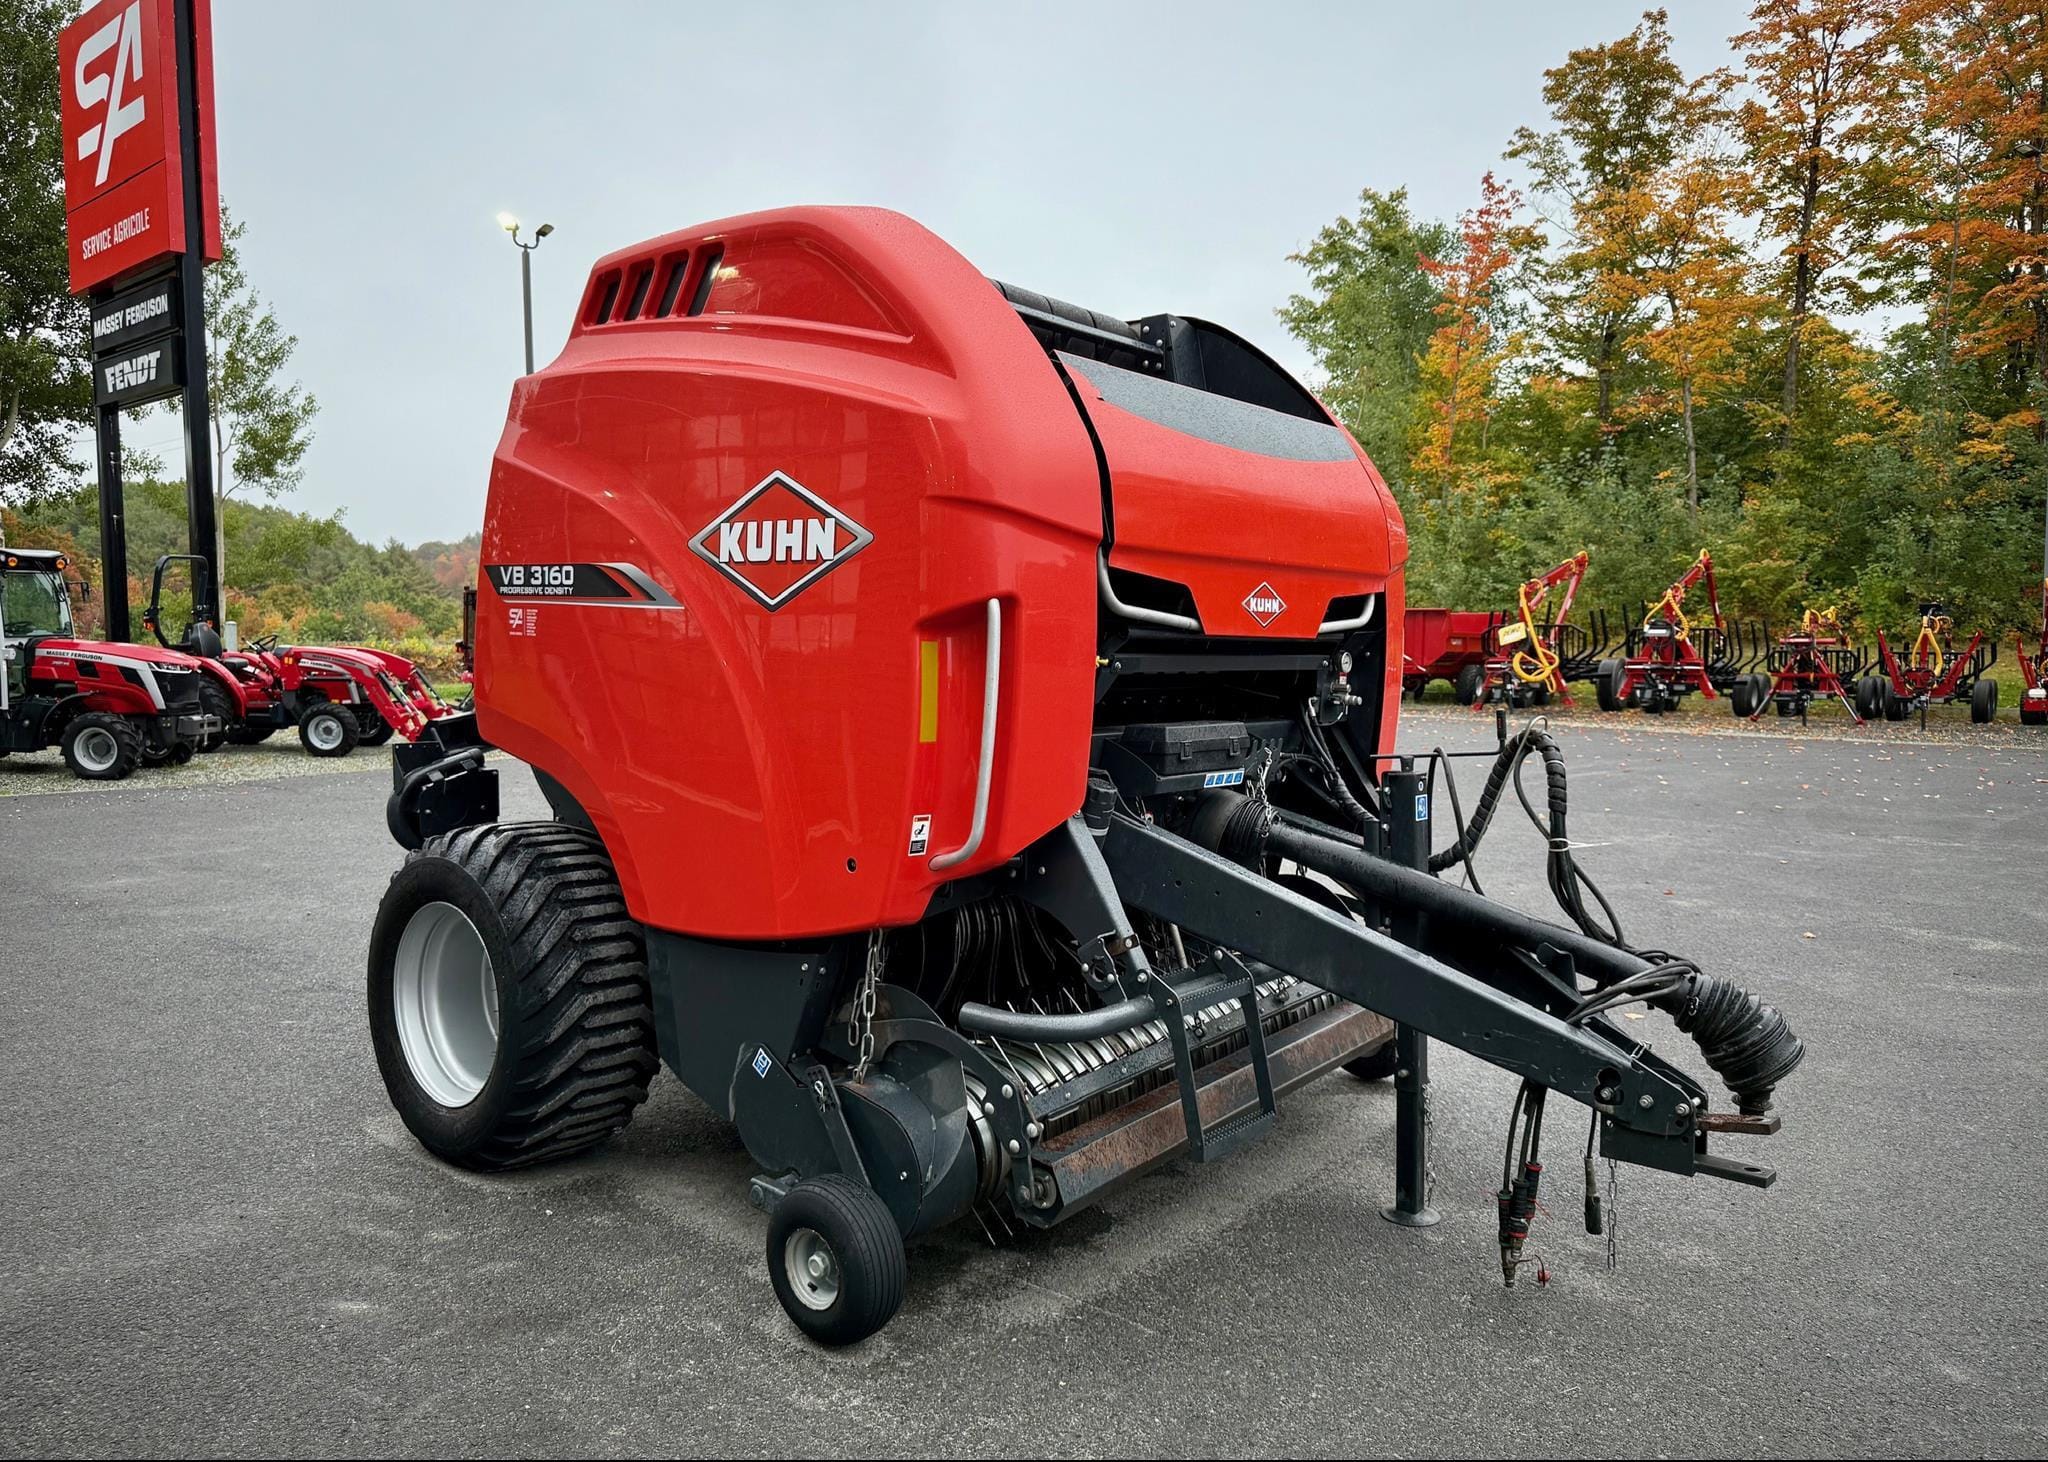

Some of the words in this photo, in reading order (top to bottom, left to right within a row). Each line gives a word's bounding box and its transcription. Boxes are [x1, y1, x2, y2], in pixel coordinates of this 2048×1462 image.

[83, 227, 112, 260] SERVICE
[113, 207, 150, 245] AGRICOLE
[93, 310, 124, 338] MASSEY
[125, 293, 168, 327] FERGUSON
[104, 350, 161, 393] FENDT
[719, 517, 836, 564] KUHN
[500, 566, 525, 585] VB
[530, 565, 574, 585] 3160
[500, 586, 543, 595] PROGRESSIVE
[544, 587, 574, 595] DENSITY
[1249, 597, 1280, 613] KUHN
[70, 651, 103, 661] FERGUSON
